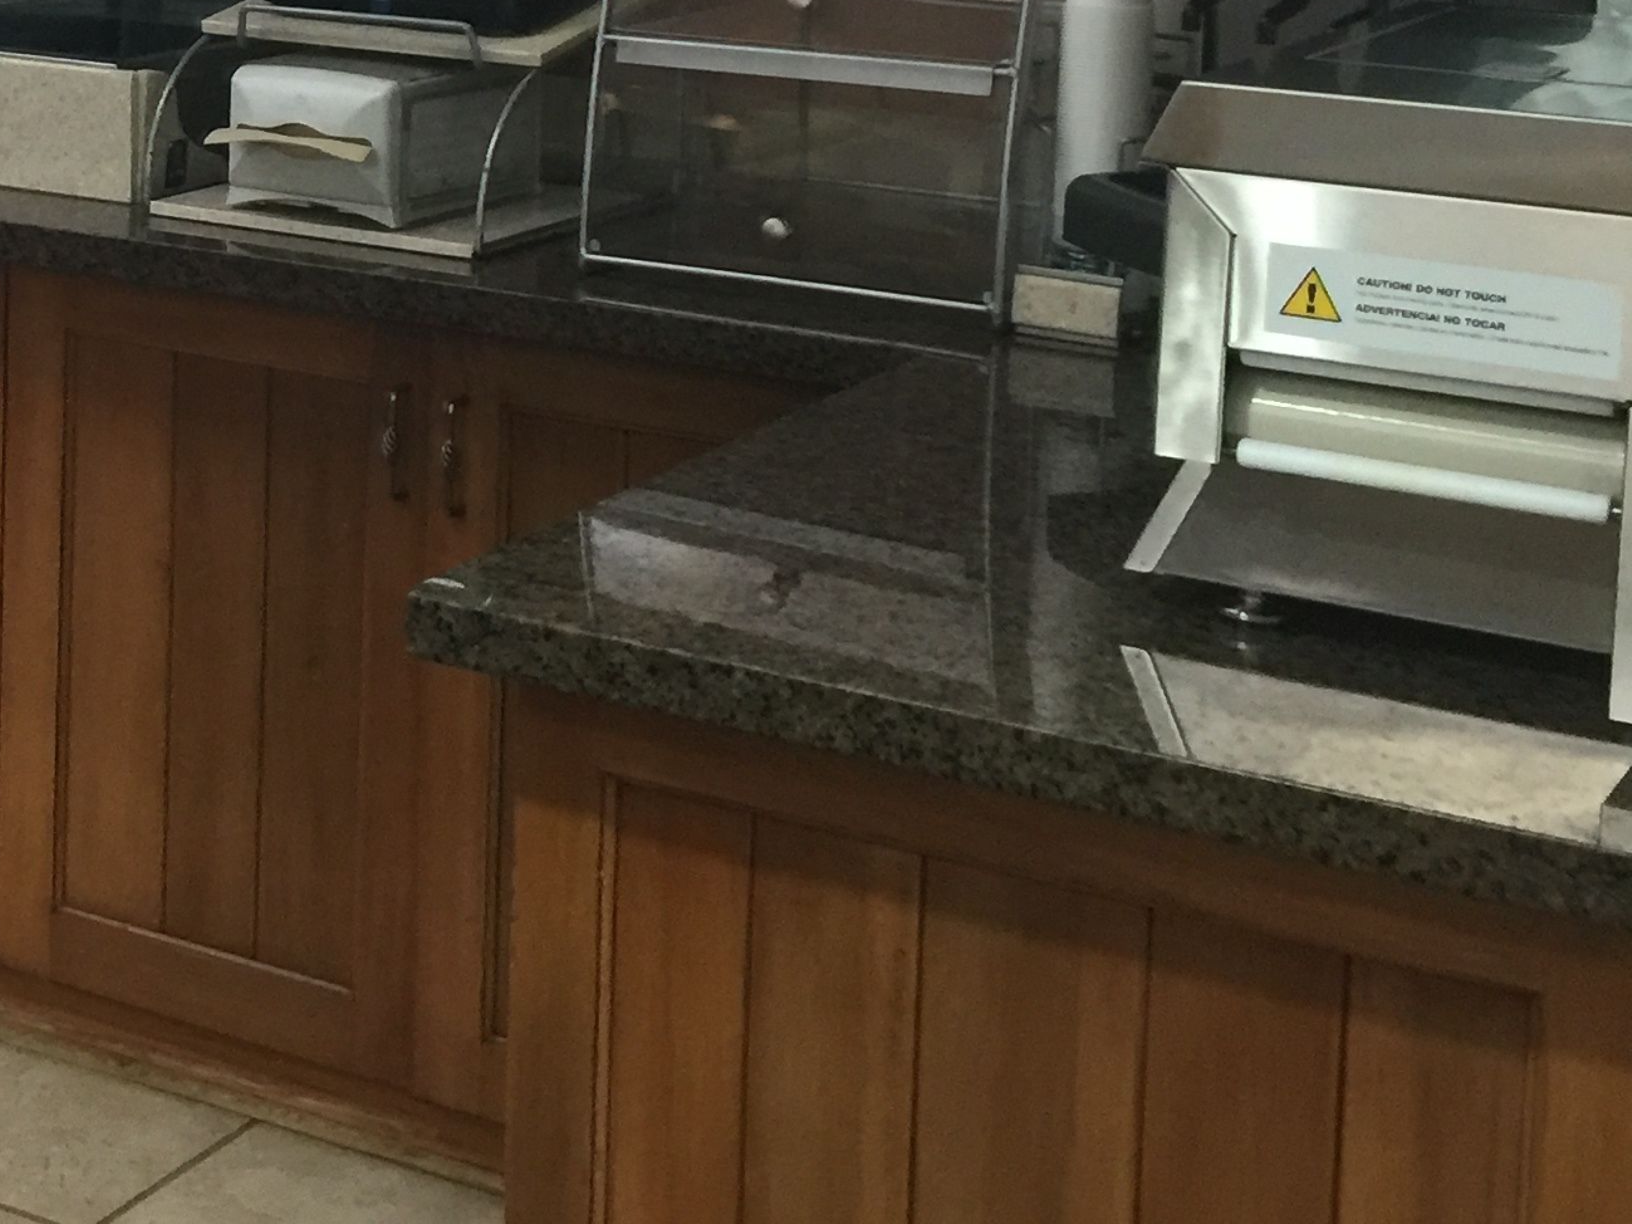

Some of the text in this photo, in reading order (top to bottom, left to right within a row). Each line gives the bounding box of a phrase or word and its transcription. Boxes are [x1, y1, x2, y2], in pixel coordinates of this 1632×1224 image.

[1416, 284, 1433, 295] DO
[1436, 287, 1461, 299] NOT
[1465, 289, 1507, 304] TOUCH
[1443, 315, 1461, 326] NO
[1465, 317, 1506, 332] TOCAR
